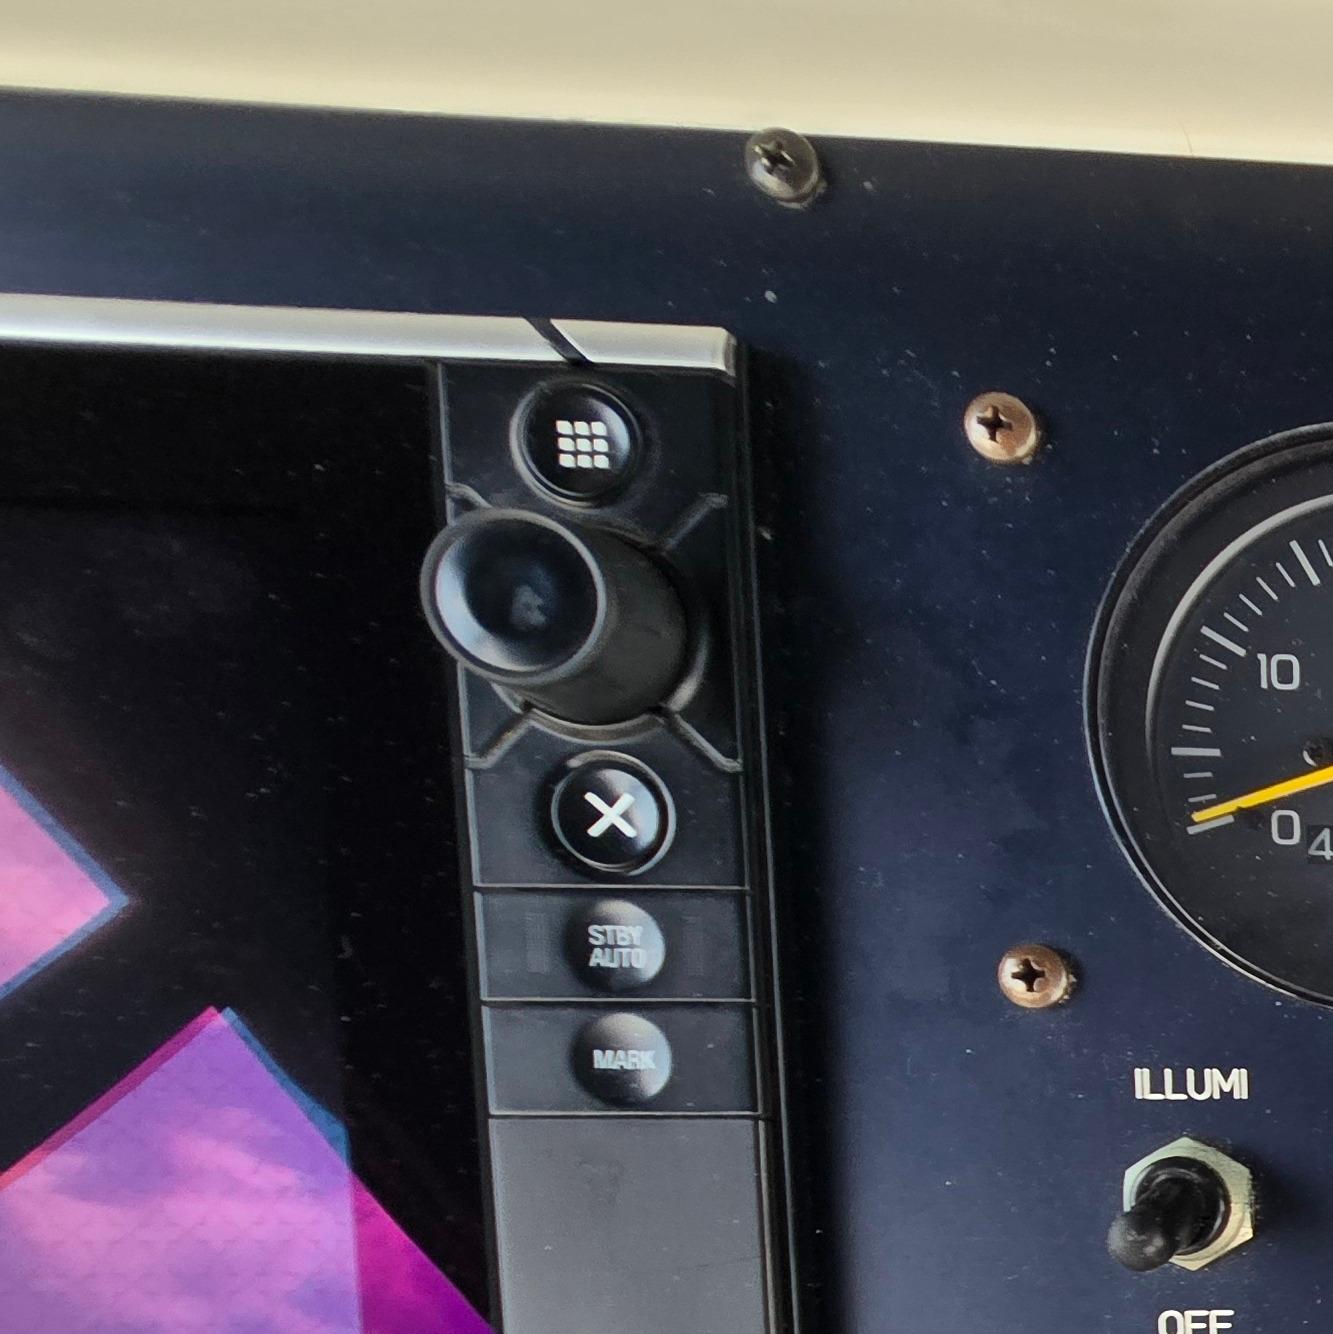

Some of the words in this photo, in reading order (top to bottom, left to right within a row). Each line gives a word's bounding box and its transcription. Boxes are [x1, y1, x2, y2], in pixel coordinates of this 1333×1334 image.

[1258, 653, 1301, 690] 10
[1270, 810, 1301, 846] 0
[587, 924, 643, 946] STBY
[588, 947, 646, 969] AUTO
[592, 1049, 656, 1069] MARK
[1134, 1067, 1250, 1100] ILLUMI
